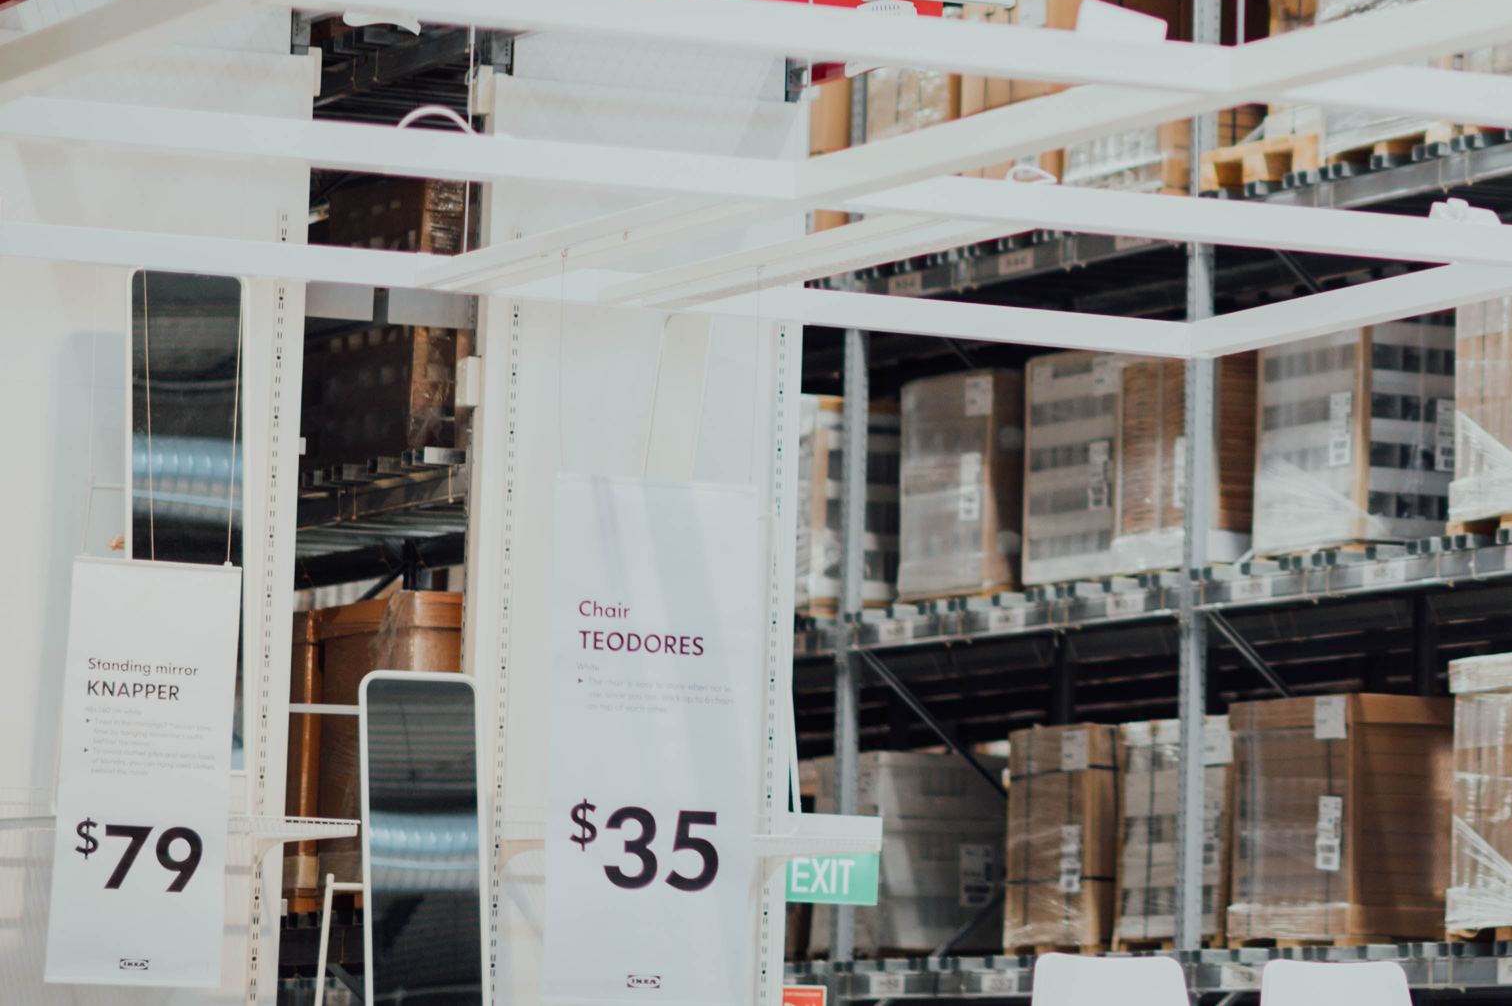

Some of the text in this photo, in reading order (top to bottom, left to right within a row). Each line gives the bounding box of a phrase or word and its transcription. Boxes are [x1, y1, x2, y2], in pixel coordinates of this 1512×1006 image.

[578, 600, 631, 619] Chair
[578, 630, 704, 656] TEODORES
[88, 658, 199, 677] Standing mirror
[87, 680, 180, 700] KNAPPER
[75, 817, 203, 893] $79
[569, 798, 719, 892] $35
[790, 858, 856, 895] EXIT
